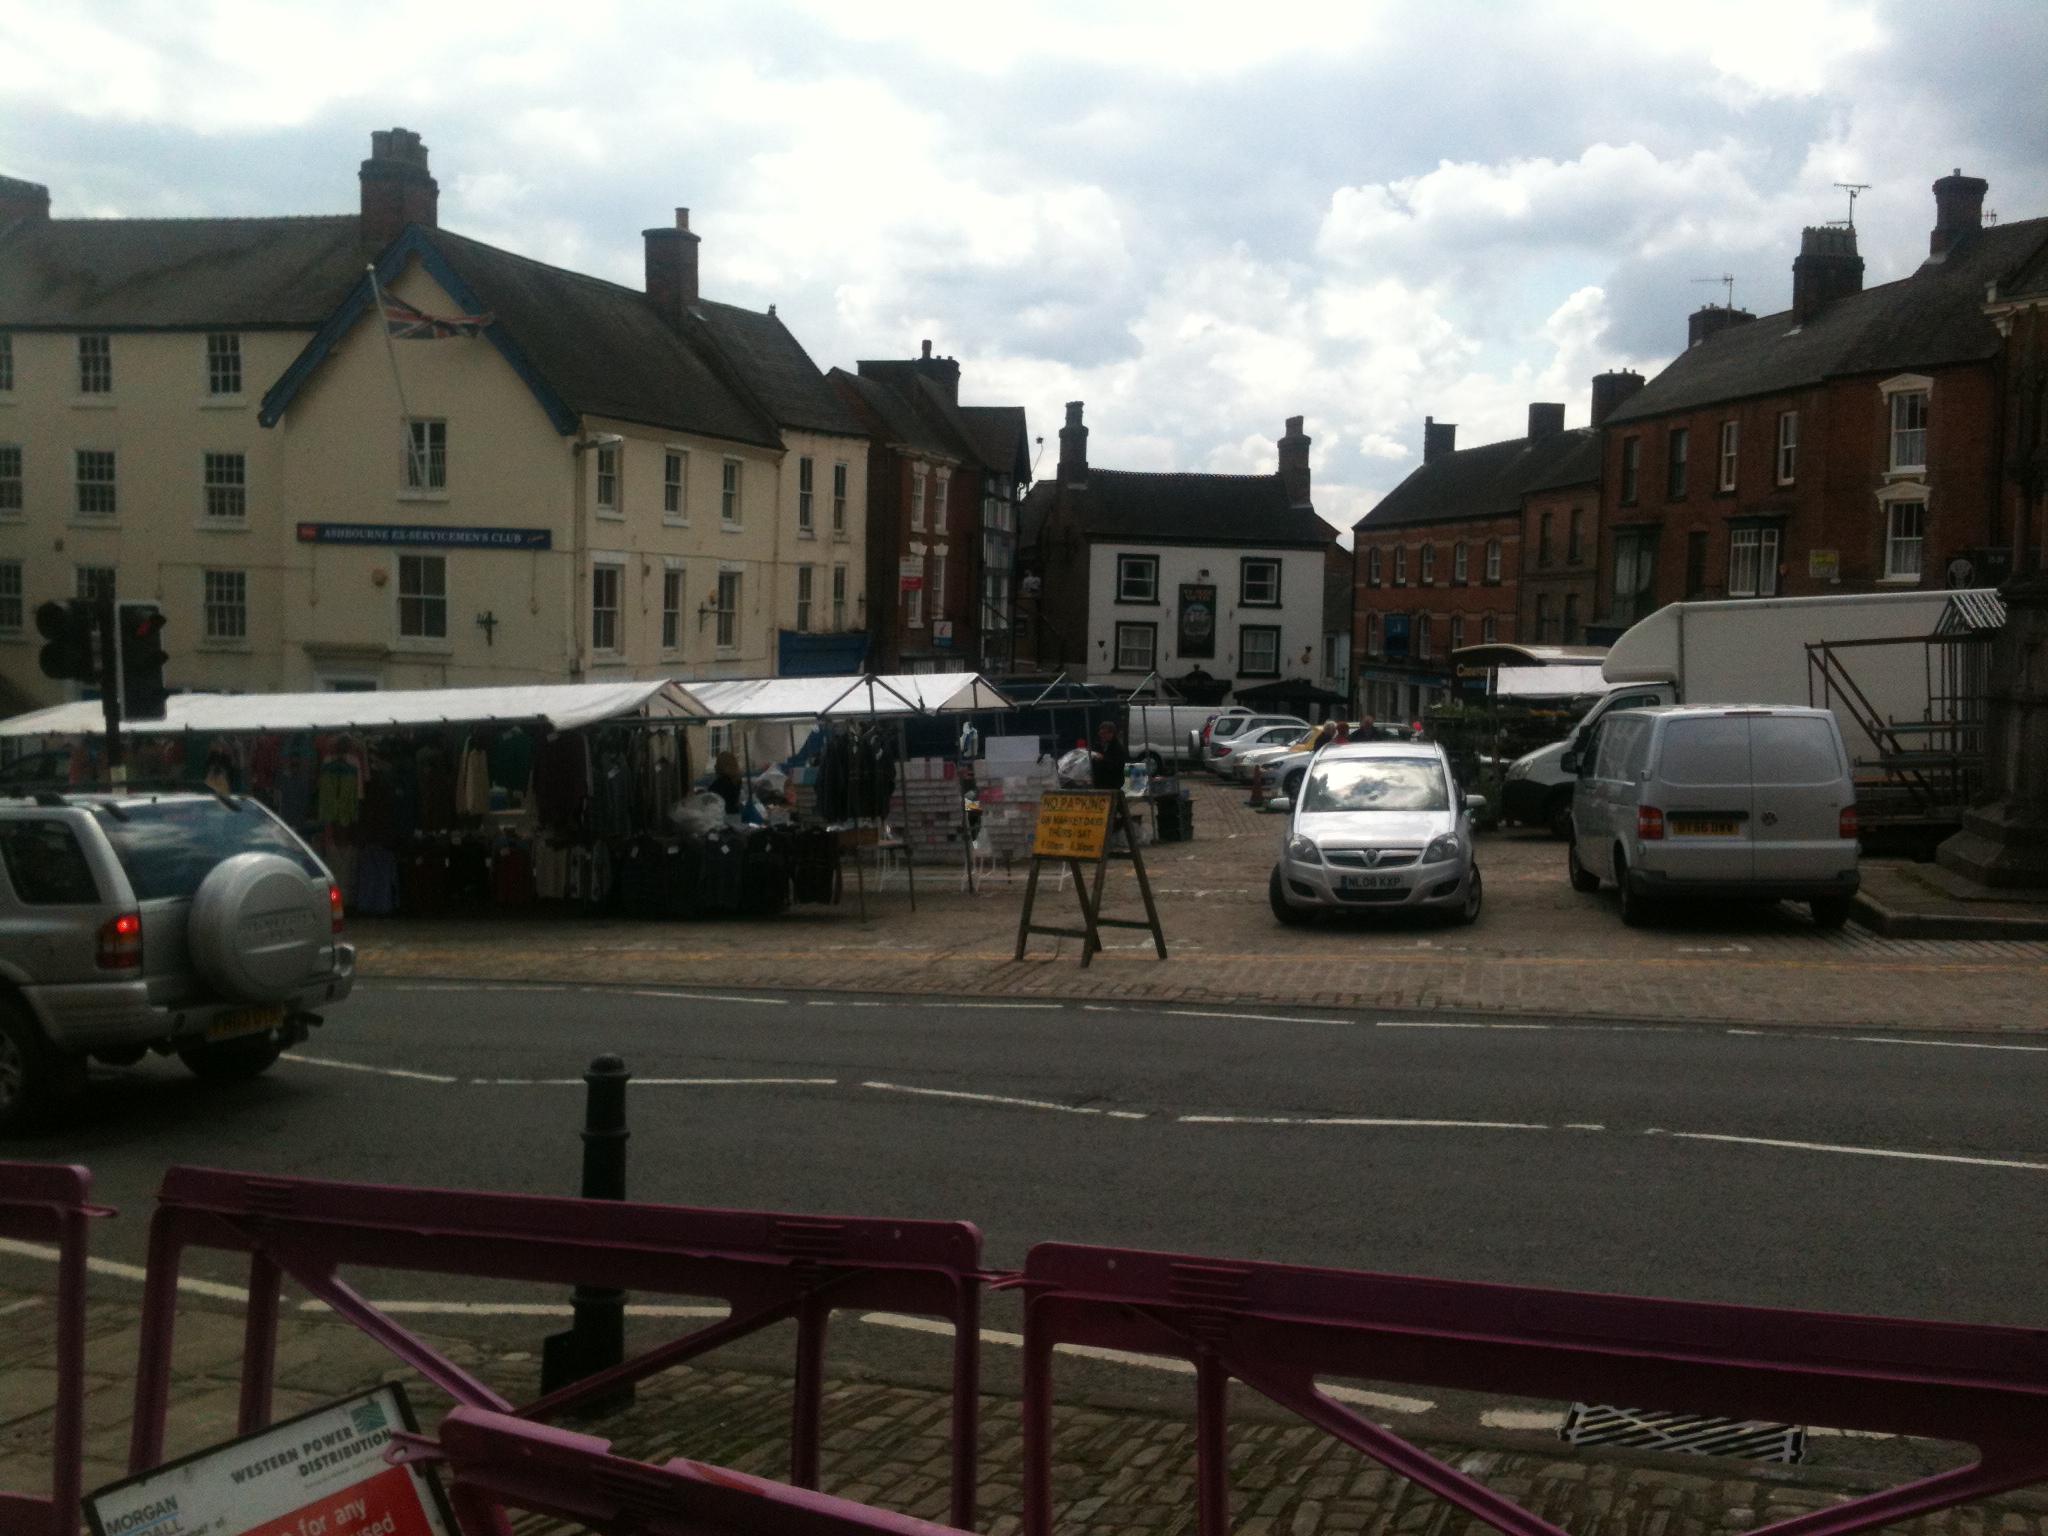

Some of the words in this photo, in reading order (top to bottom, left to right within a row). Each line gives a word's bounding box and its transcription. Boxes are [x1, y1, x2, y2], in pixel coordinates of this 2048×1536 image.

[323, 528, 389, 540] ASHBOURNE
[491, 533, 521, 544] CLUB
[1043, 797, 1058, 809] NO
[1061, 797, 1107, 811] PARKING
[1348, 876, 1376, 888] NL08
[1379, 876, 1401, 888] KXP
[230, 1447, 299, 1484] WESTERN
[302, 1427, 353, 1456] POWER
[299, 1428, 392, 1477] DISTRIBUTION
[105, 1494, 179, 1534] MORGAN
[298, 1516, 327, 1536] for
[334, 1498, 366, 1525] any
